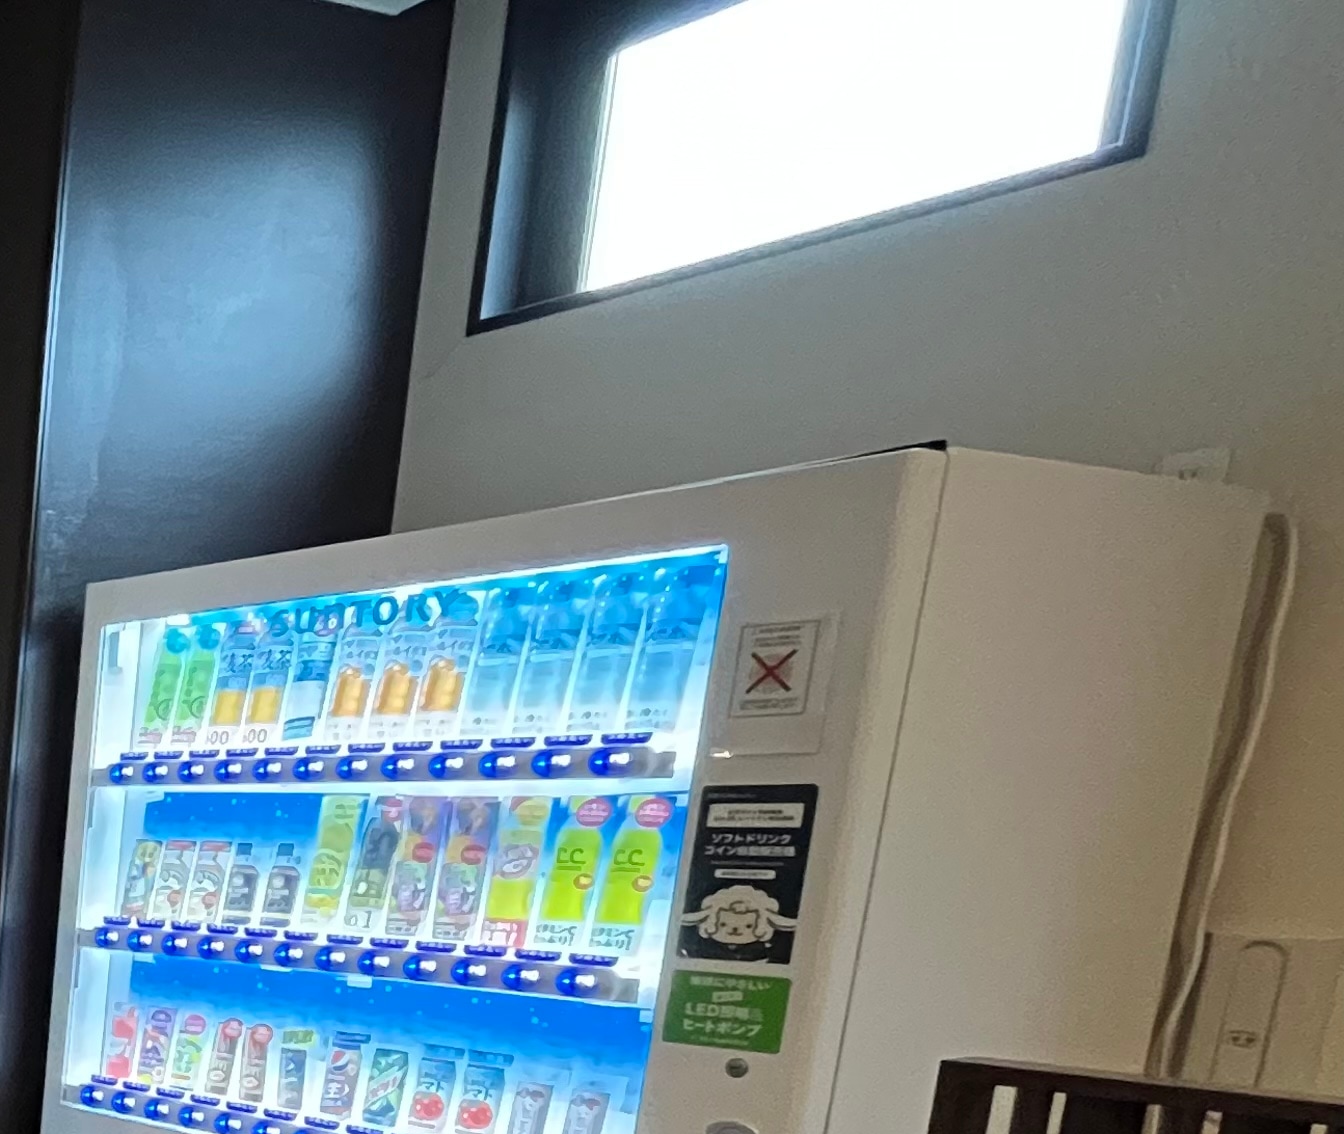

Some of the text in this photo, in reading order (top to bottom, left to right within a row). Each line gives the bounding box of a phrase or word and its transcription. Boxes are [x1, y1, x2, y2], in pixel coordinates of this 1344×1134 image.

[682, 1018, 763, 1037] ヒートポンプ
